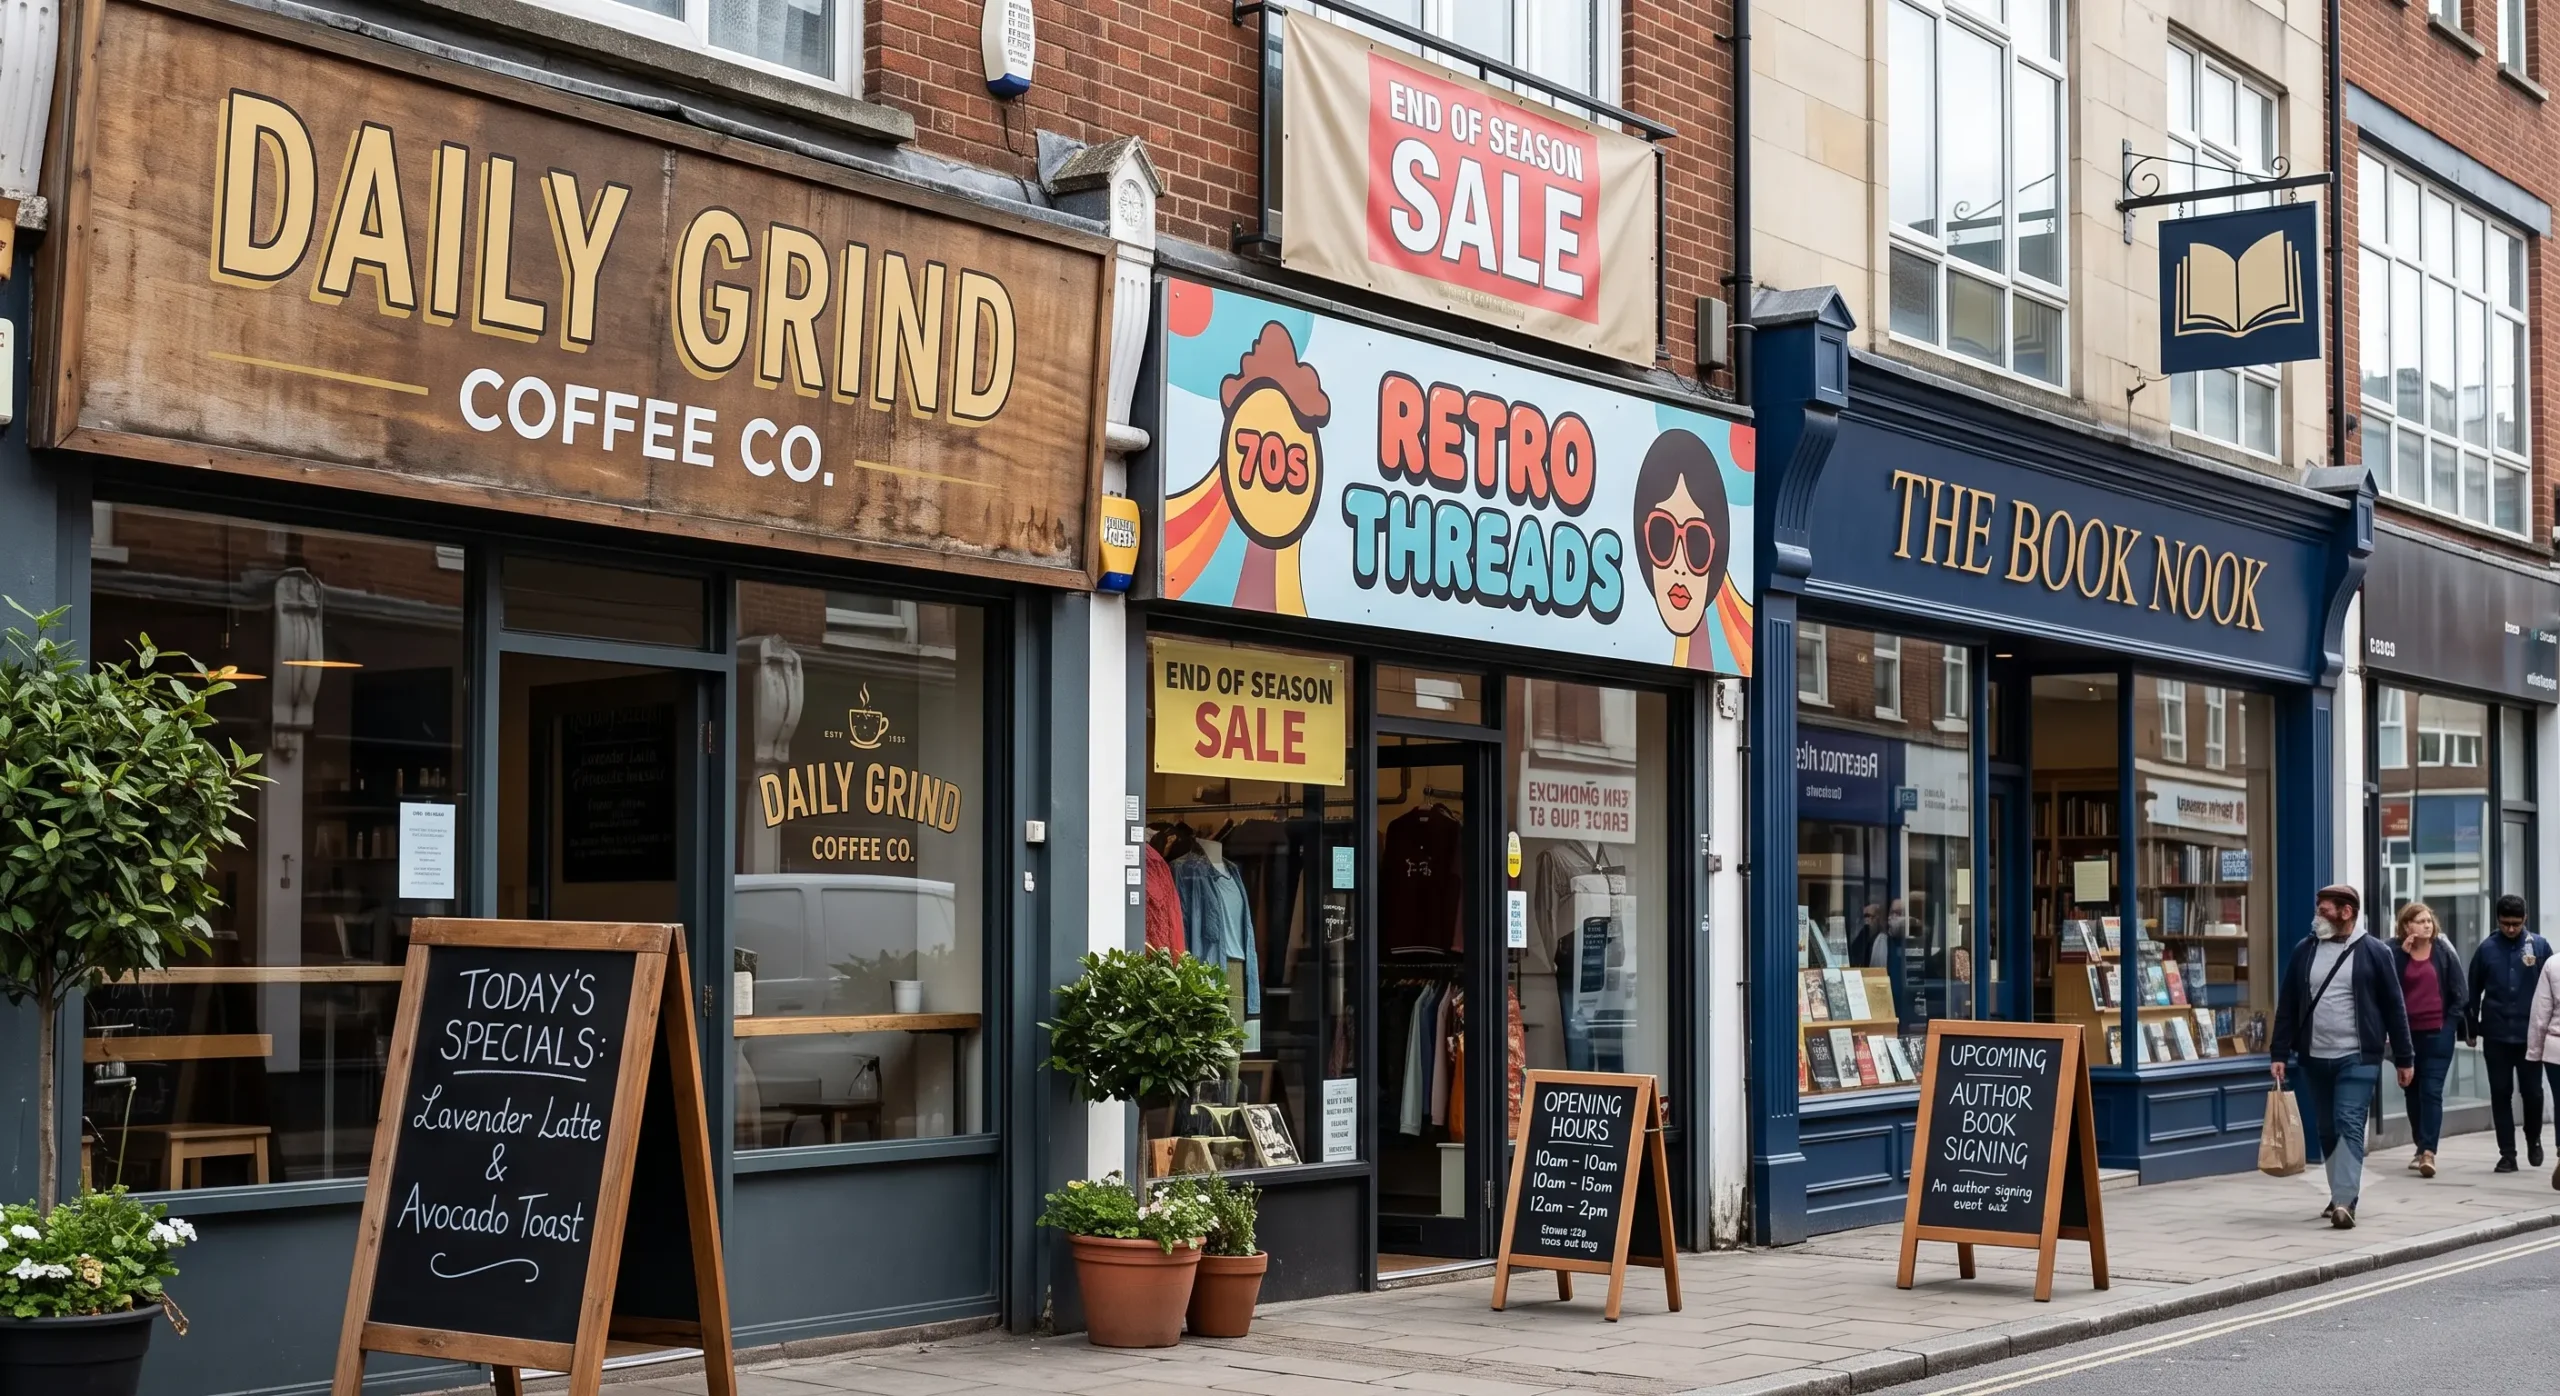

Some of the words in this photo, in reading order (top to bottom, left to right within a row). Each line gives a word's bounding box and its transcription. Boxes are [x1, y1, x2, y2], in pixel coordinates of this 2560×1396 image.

[1389, 80, 1443, 133] END
[1450, 103, 1482, 142] OF
[1489, 115, 1583, 183] SEASON
[1389, 137, 1585, 300] SALE
[210, 87, 633, 353] DAILY
[671, 205, 1017, 428] GRIND
[459, 367, 717, 467] COFFEE
[740, 417, 834, 486] CO.
[1377, 371, 1597, 517] RETRO
[1344, 483, 1624, 625] THREADS
[1892, 469, 1996, 575] THE
[2005, 499, 2142, 607] BOOK
[2149, 534, 2269, 632] NOOK
[1166, 661, 1211, 691] END
[1217, 668, 1245, 695] OF
[1251, 671, 1333, 705] SEASON
[1194, 701, 1306, 765] SALE
[758, 761, 854, 828] DAILY
[865, 762, 962, 834] GRIND
[812, 836, 881, 861] COFFEE
[886, 838, 915, 862] CO.
[460, 968, 596, 1017] TODAY'S
[440, 1018, 607, 1069] SPECIALS:
[1950, 1044, 2047, 1075] UPCOMING
[413, 1084, 532, 1134] Lavender
[537, 1095, 601, 1142] Latte
[1544, 1091, 1622, 1118] OPENING
[1949, 1081, 2033, 1110] AUTHOR
[1550, 1116, 1609, 1141] HOURS
[1962, 1110, 2017, 1136] BOOK
[485, 1143, 508, 1182] &
[1535, 1149, 1568, 1168] 10am
[1584, 1153, 1618, 1172] 10am
[1944, 1136, 2028, 1170] SIGNING
[1532, 1172, 1565, 1189] 10am
[1931, 1178, 1947, 1193] An
[1952, 1180, 1990, 1194] author
[1995, 1184, 2033, 1204] signing
[397, 1182, 509, 1234] Avocado
[518, 1193, 584, 1242] Toast
[1530, 1195, 1563, 1213] 12am
[1579, 1200, 1609, 1220] 2pm
